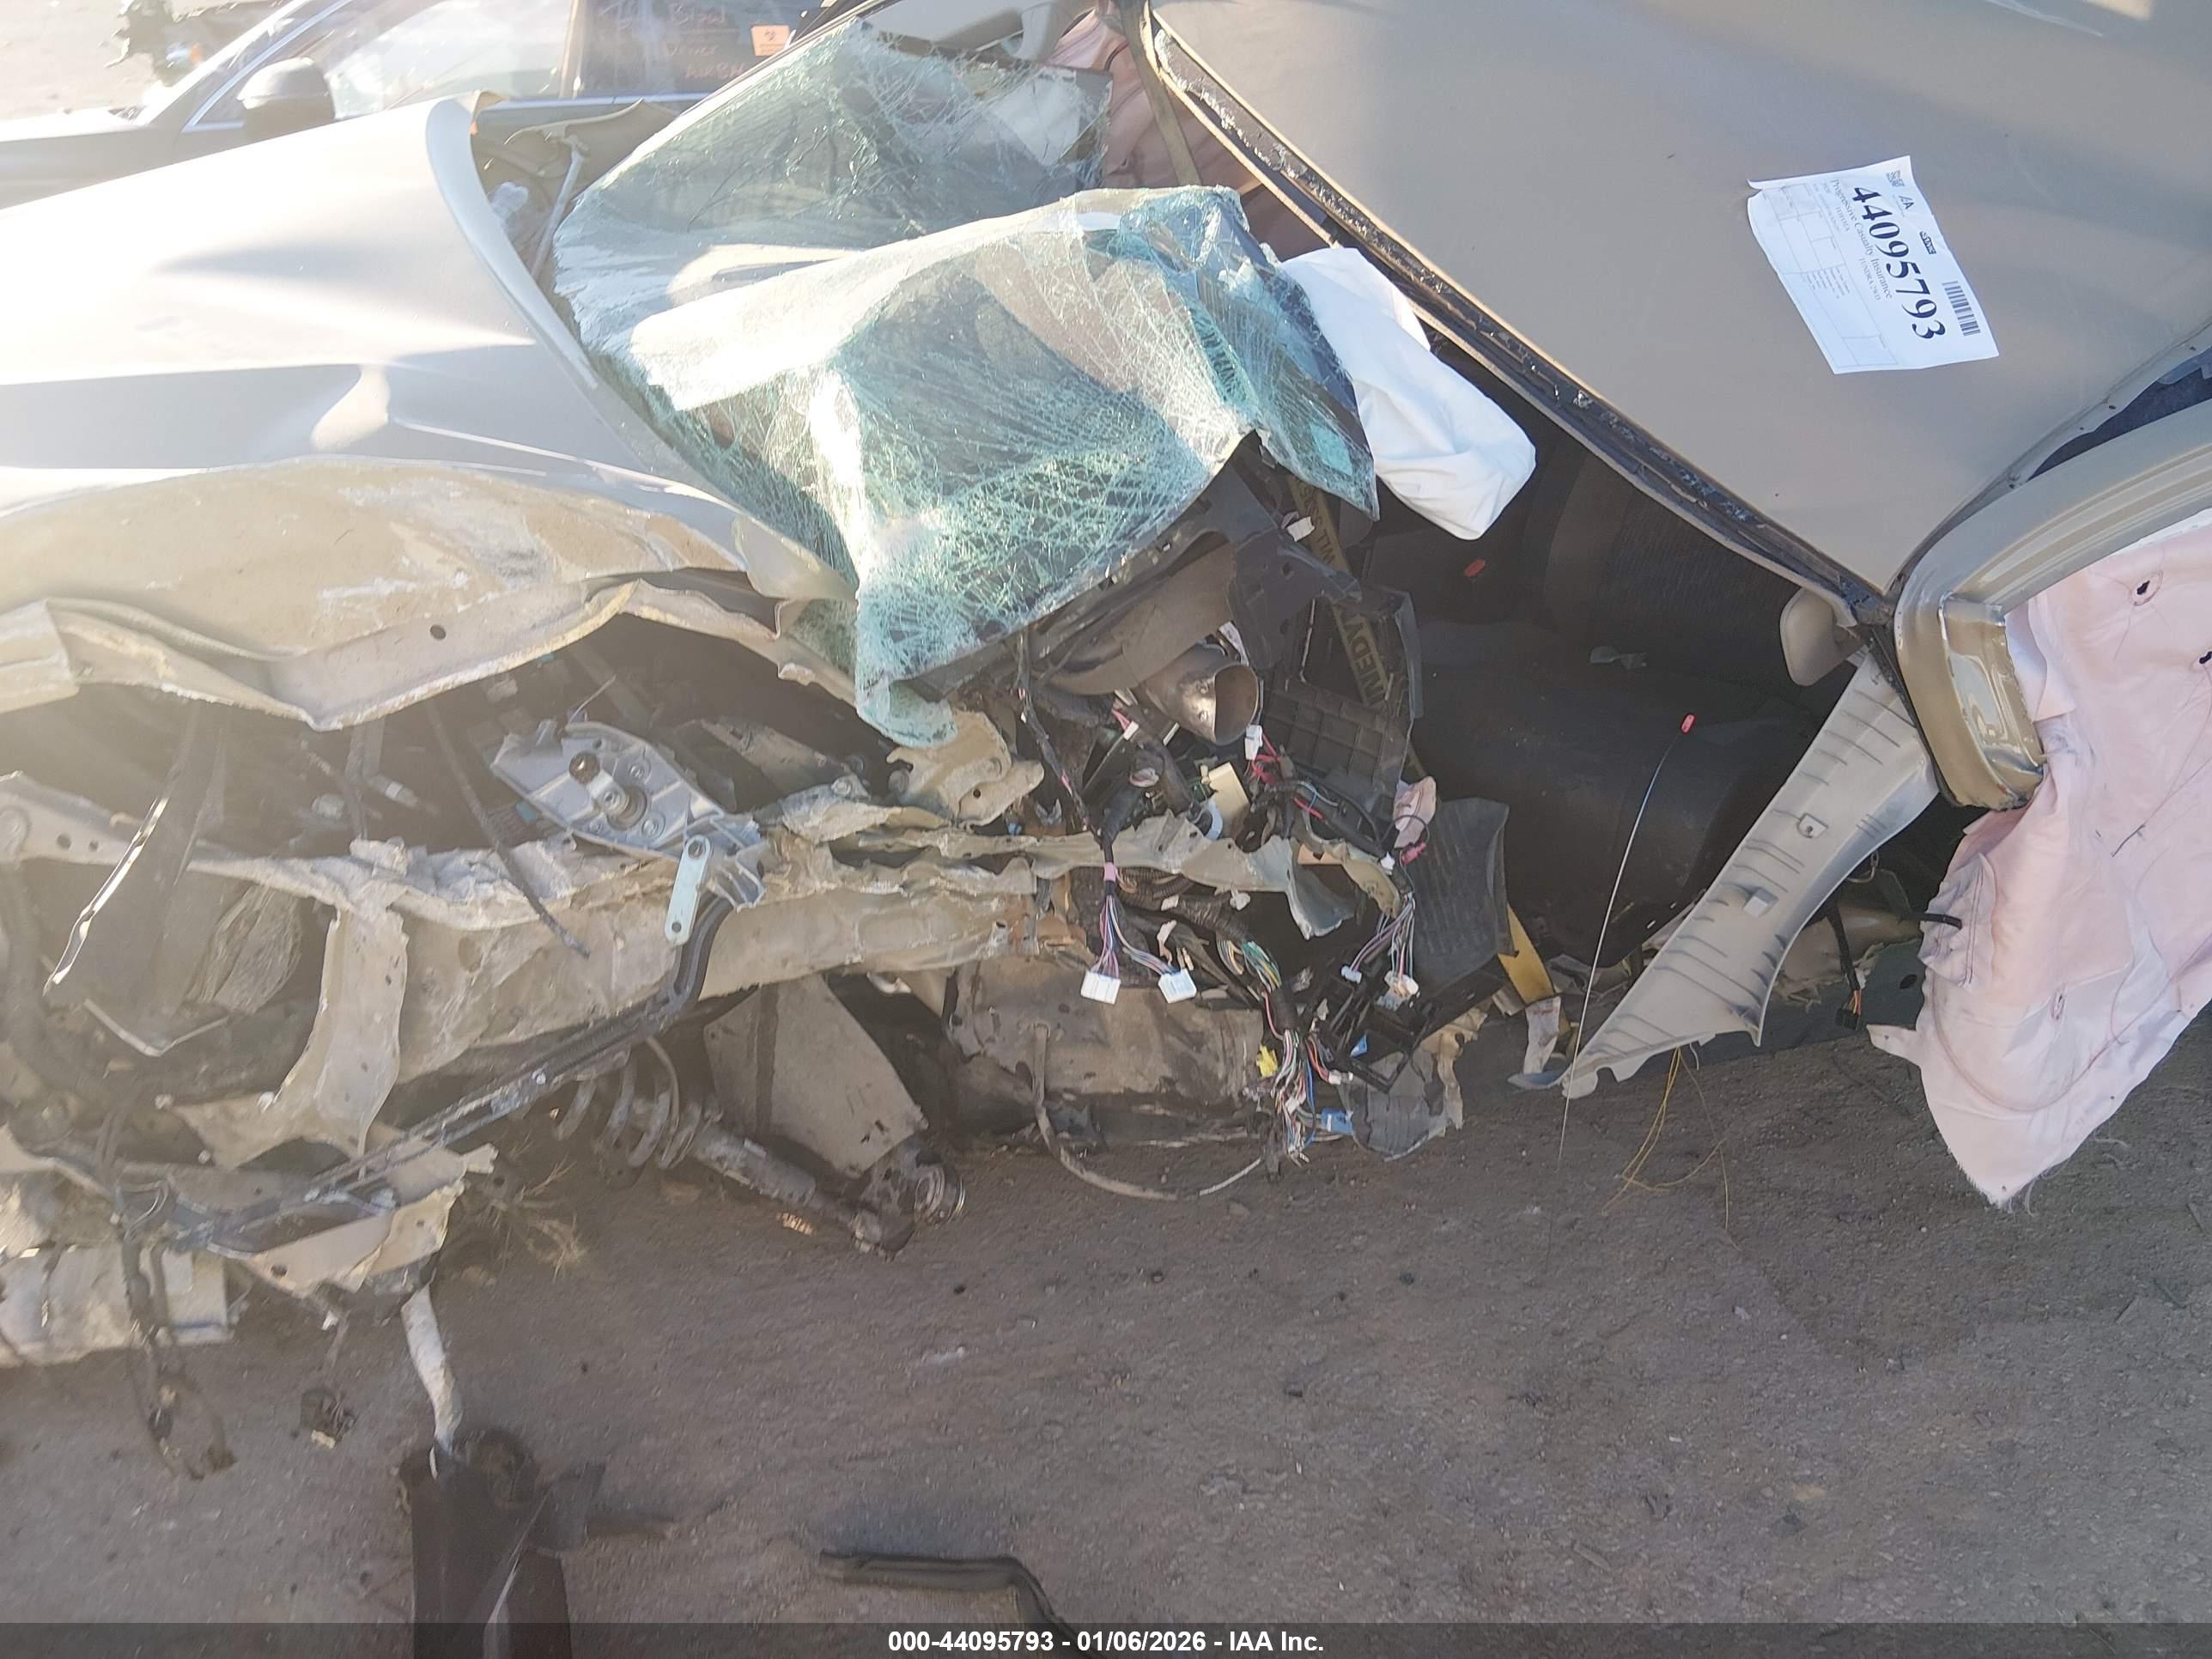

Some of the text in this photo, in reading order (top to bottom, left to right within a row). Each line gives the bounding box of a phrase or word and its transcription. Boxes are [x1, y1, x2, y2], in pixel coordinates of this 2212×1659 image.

[1830, 179, 1893, 299] Progressive Casualty Insurance
[1852, 187, 1946, 339] 44095793
